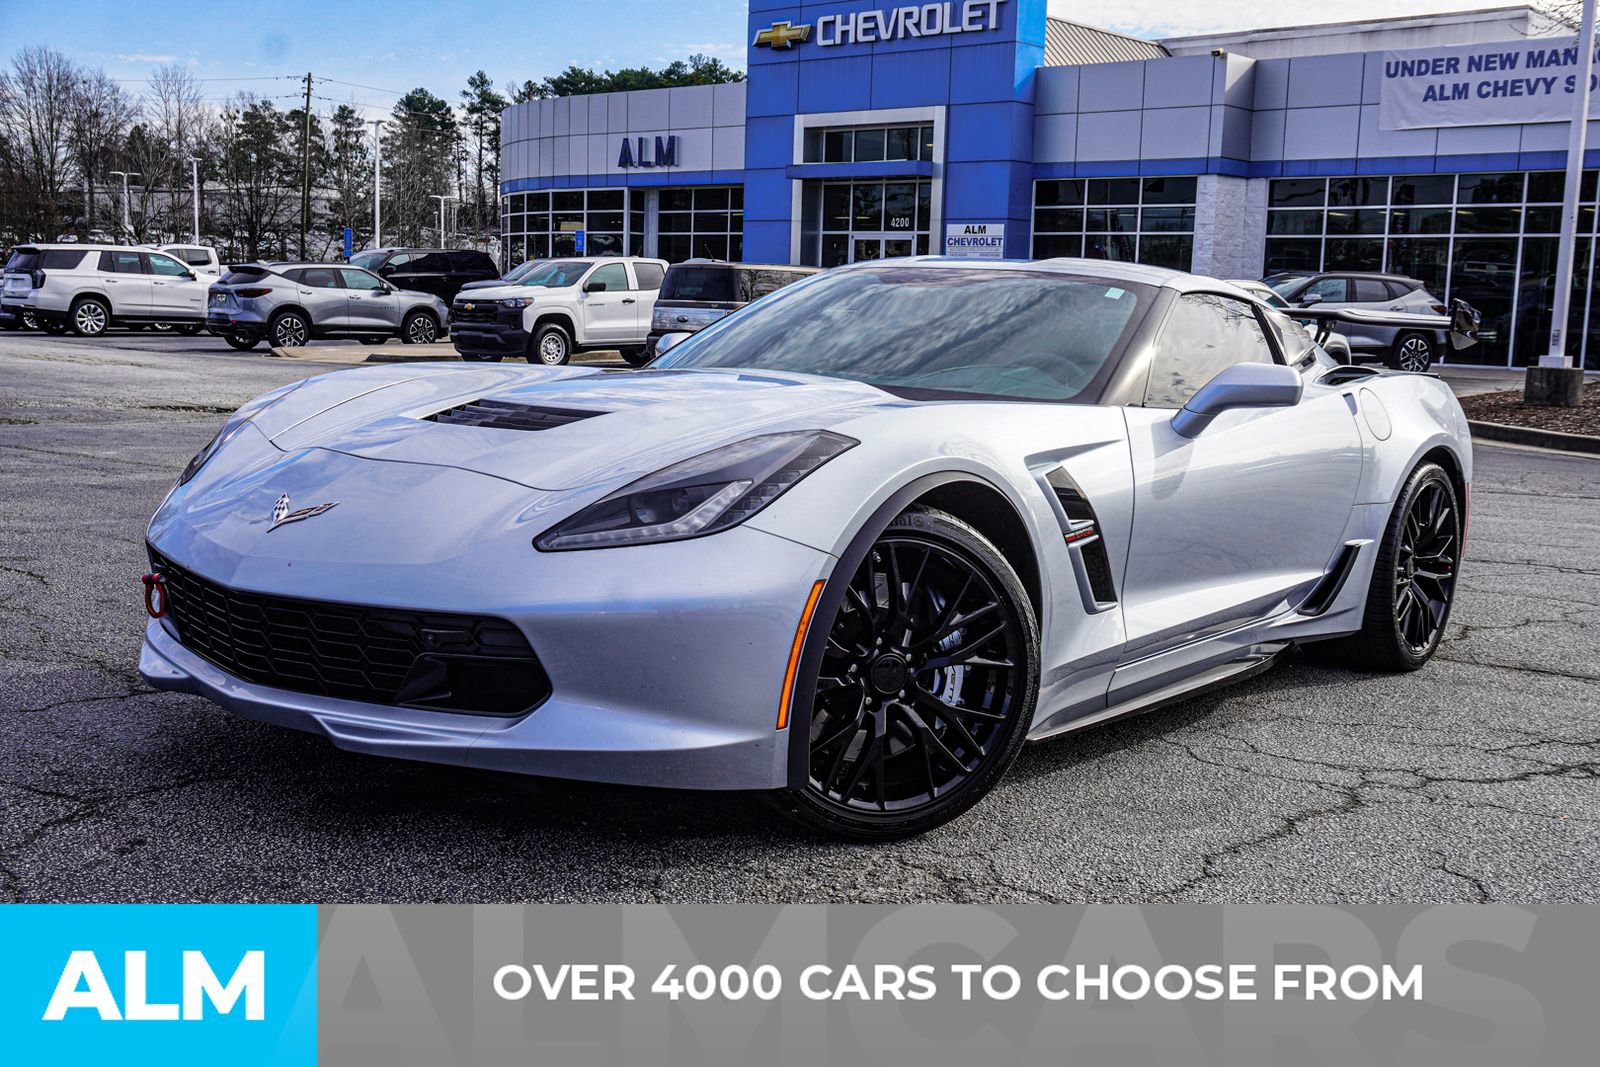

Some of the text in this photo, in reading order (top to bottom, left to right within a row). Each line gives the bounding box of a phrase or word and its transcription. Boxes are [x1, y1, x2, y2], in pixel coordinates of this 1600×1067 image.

[816, 0, 1006, 46] CHEVROLET
[1385, 46, 1600, 78] UNDER NEW MAN
[1422, 83, 1470, 102] ALM
[1476, 76, 1558, 99] CHEVY
[617, 135, 678, 169] ALM
[890, 217, 910, 228] 4200
[963, 225, 987, 235] ALM
[947, 237, 1003, 246] CHEVROLET
